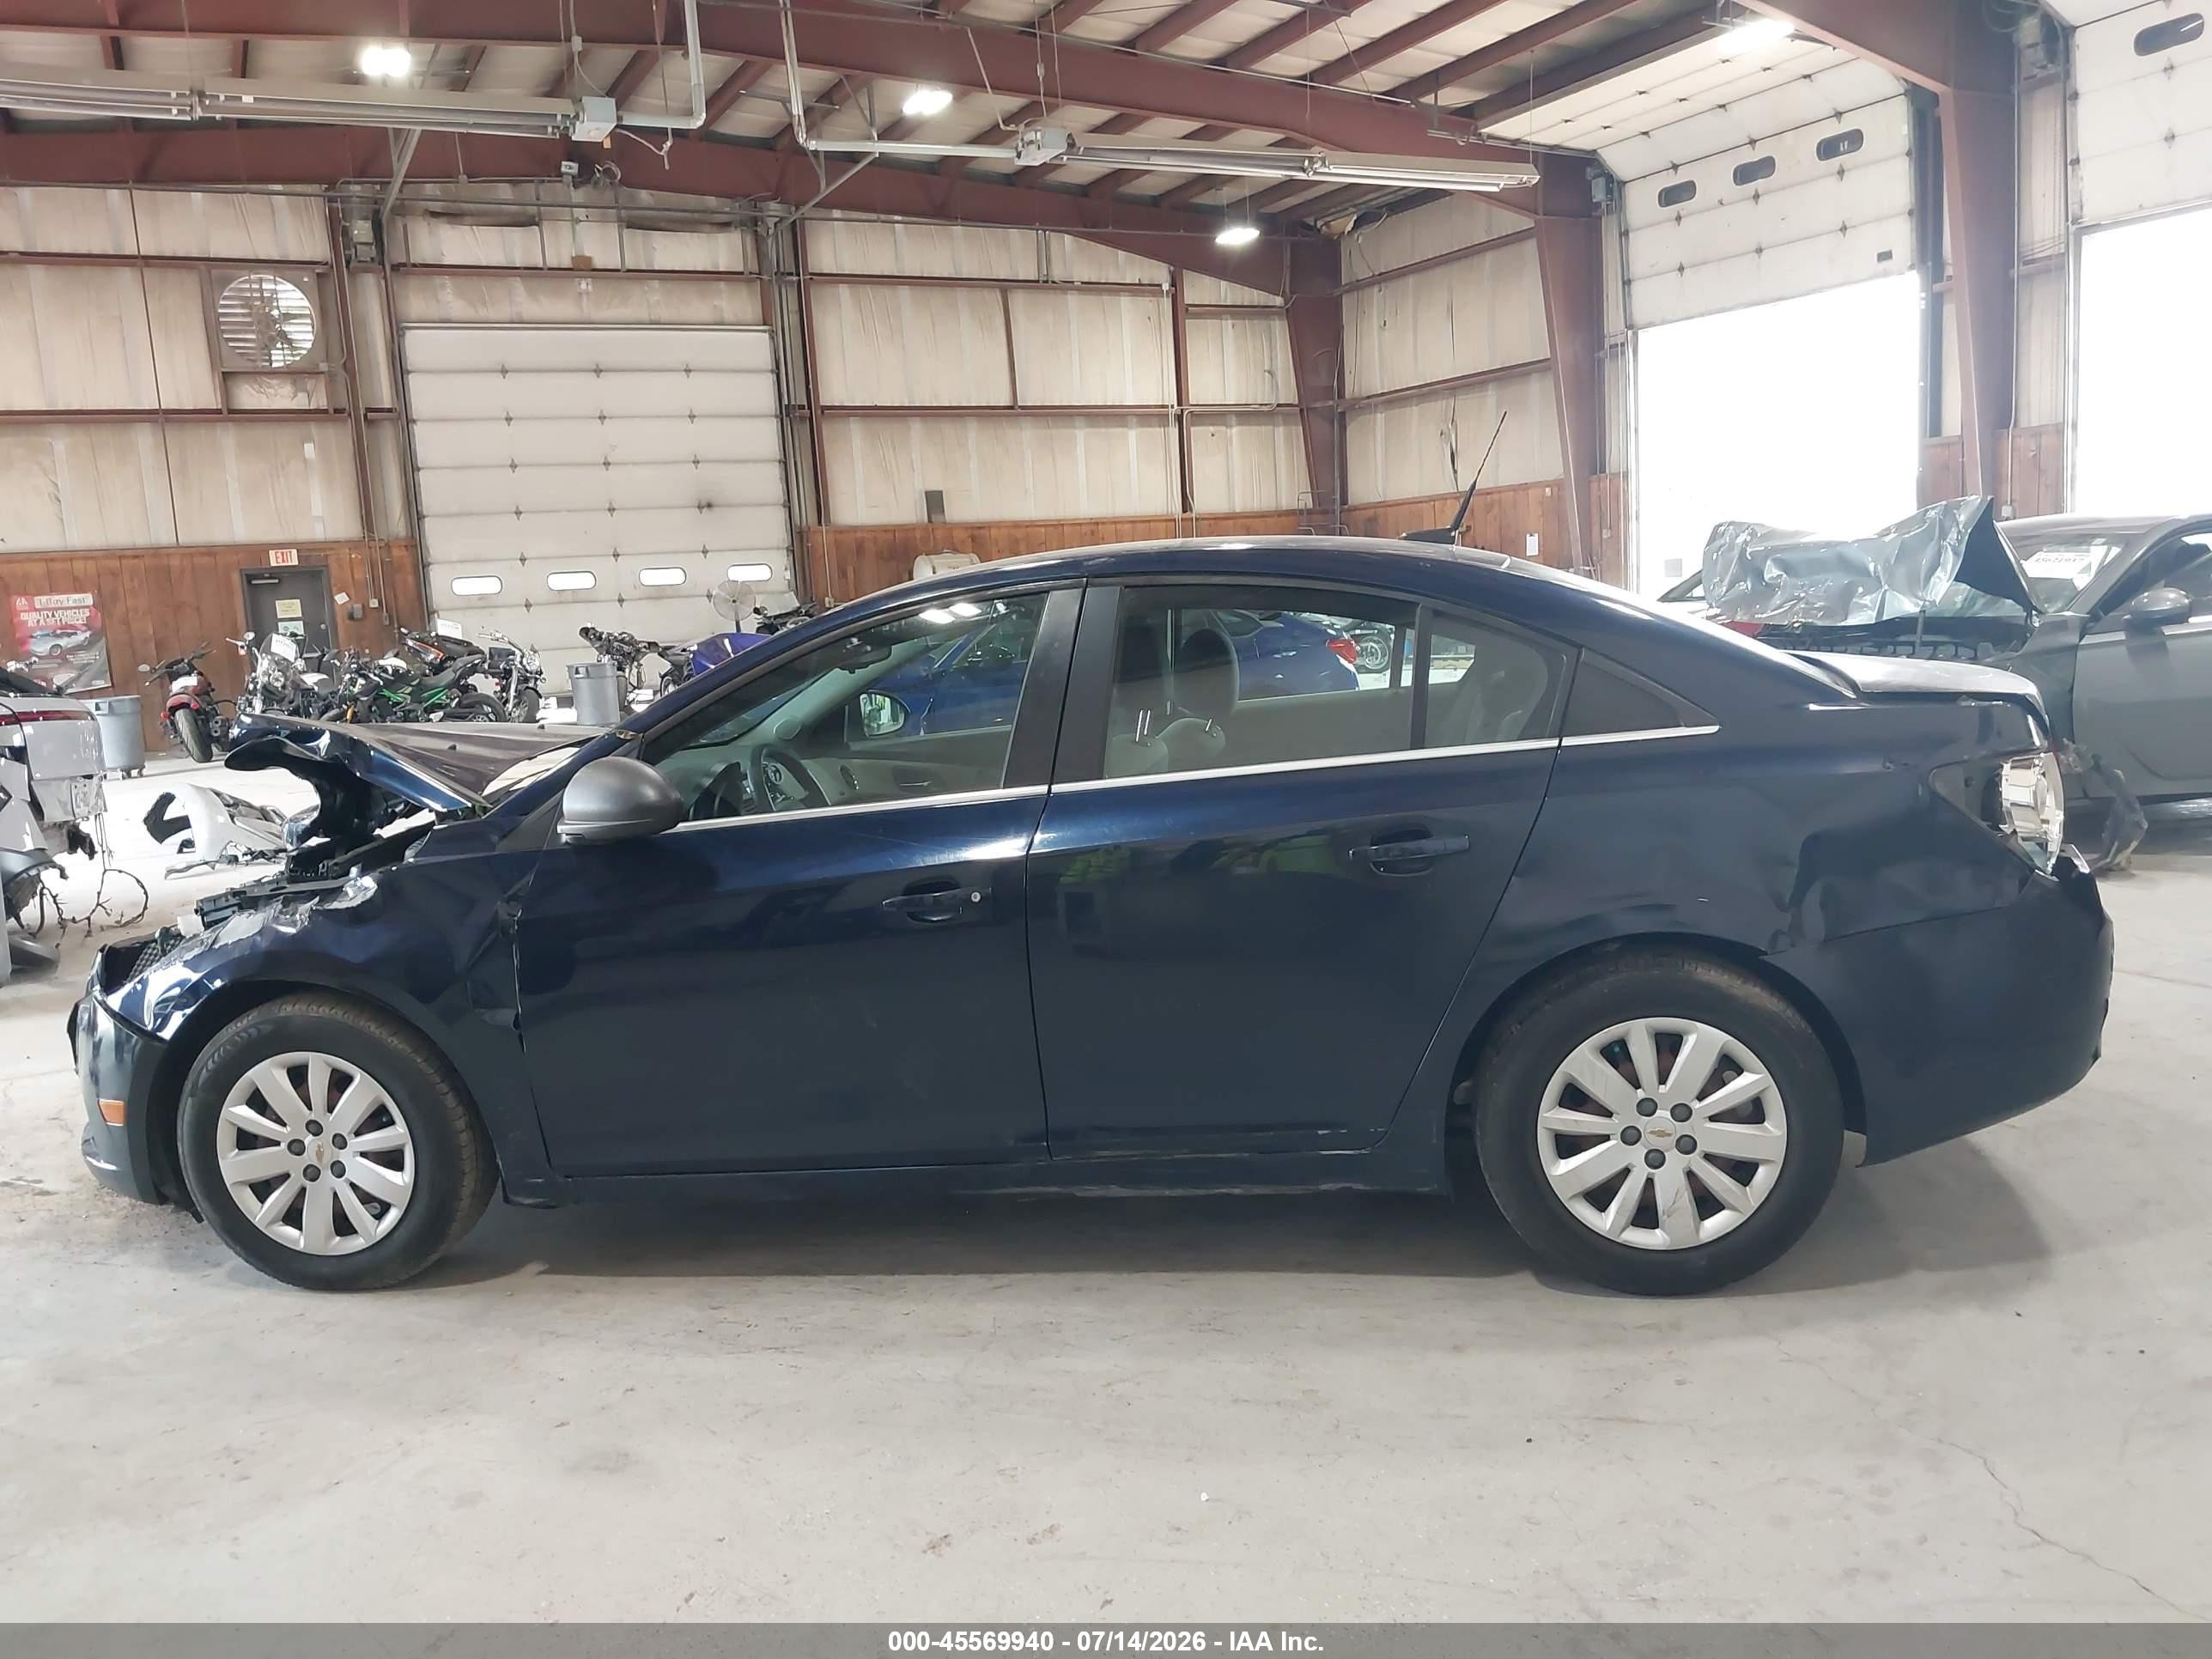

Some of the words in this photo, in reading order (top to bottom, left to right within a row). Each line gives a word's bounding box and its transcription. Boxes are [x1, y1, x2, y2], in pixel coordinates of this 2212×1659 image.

[275, 550, 293, 564] EXIT
[20, 611, 53, 620] QUALITY
[53, 608, 90, 618] VEHICLES
